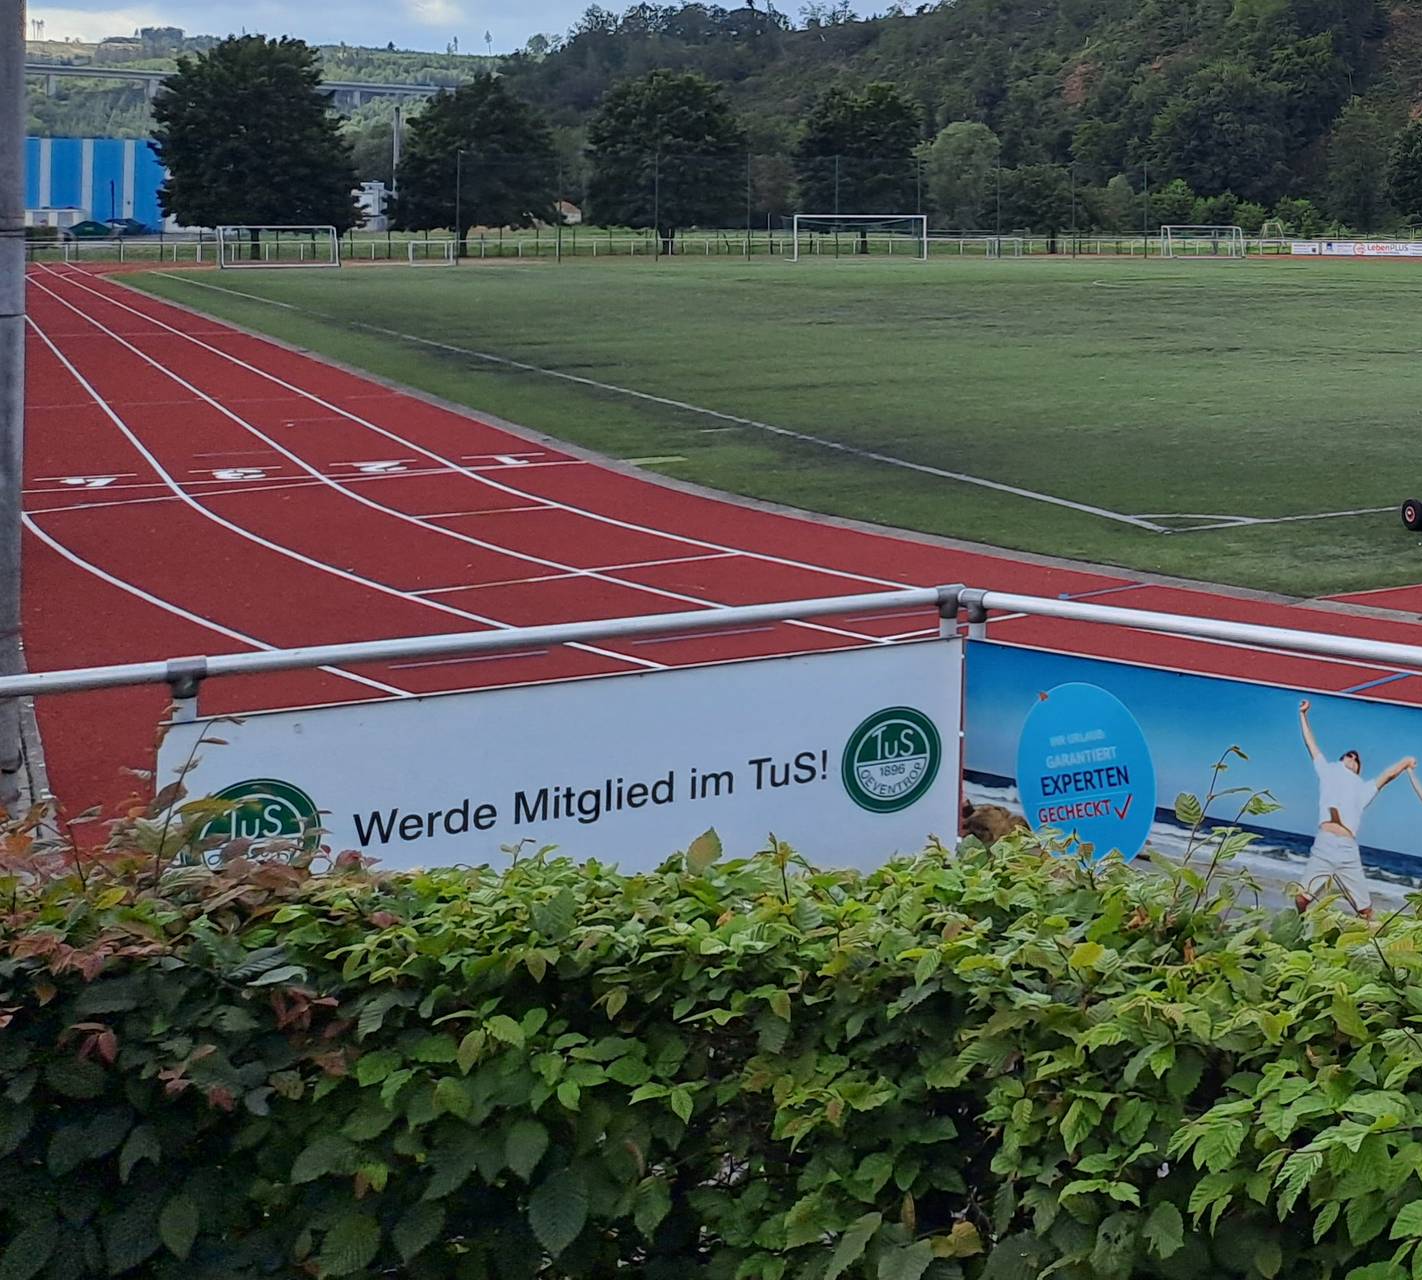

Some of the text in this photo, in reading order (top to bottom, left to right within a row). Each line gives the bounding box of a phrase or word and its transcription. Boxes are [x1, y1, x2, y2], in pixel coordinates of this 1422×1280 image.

[872, 726, 914, 760] TuS
[1046, 746, 1117, 769] GARANTIERT
[860, 762, 922, 794] OEVENTROP
[880, 763, 906, 777] 1896
[1040, 765, 1130, 796] EXPERTEN
[353, 750, 828, 847] Werde Mitglied im TuS!
[1039, 799, 1112, 824] GECHECKT
